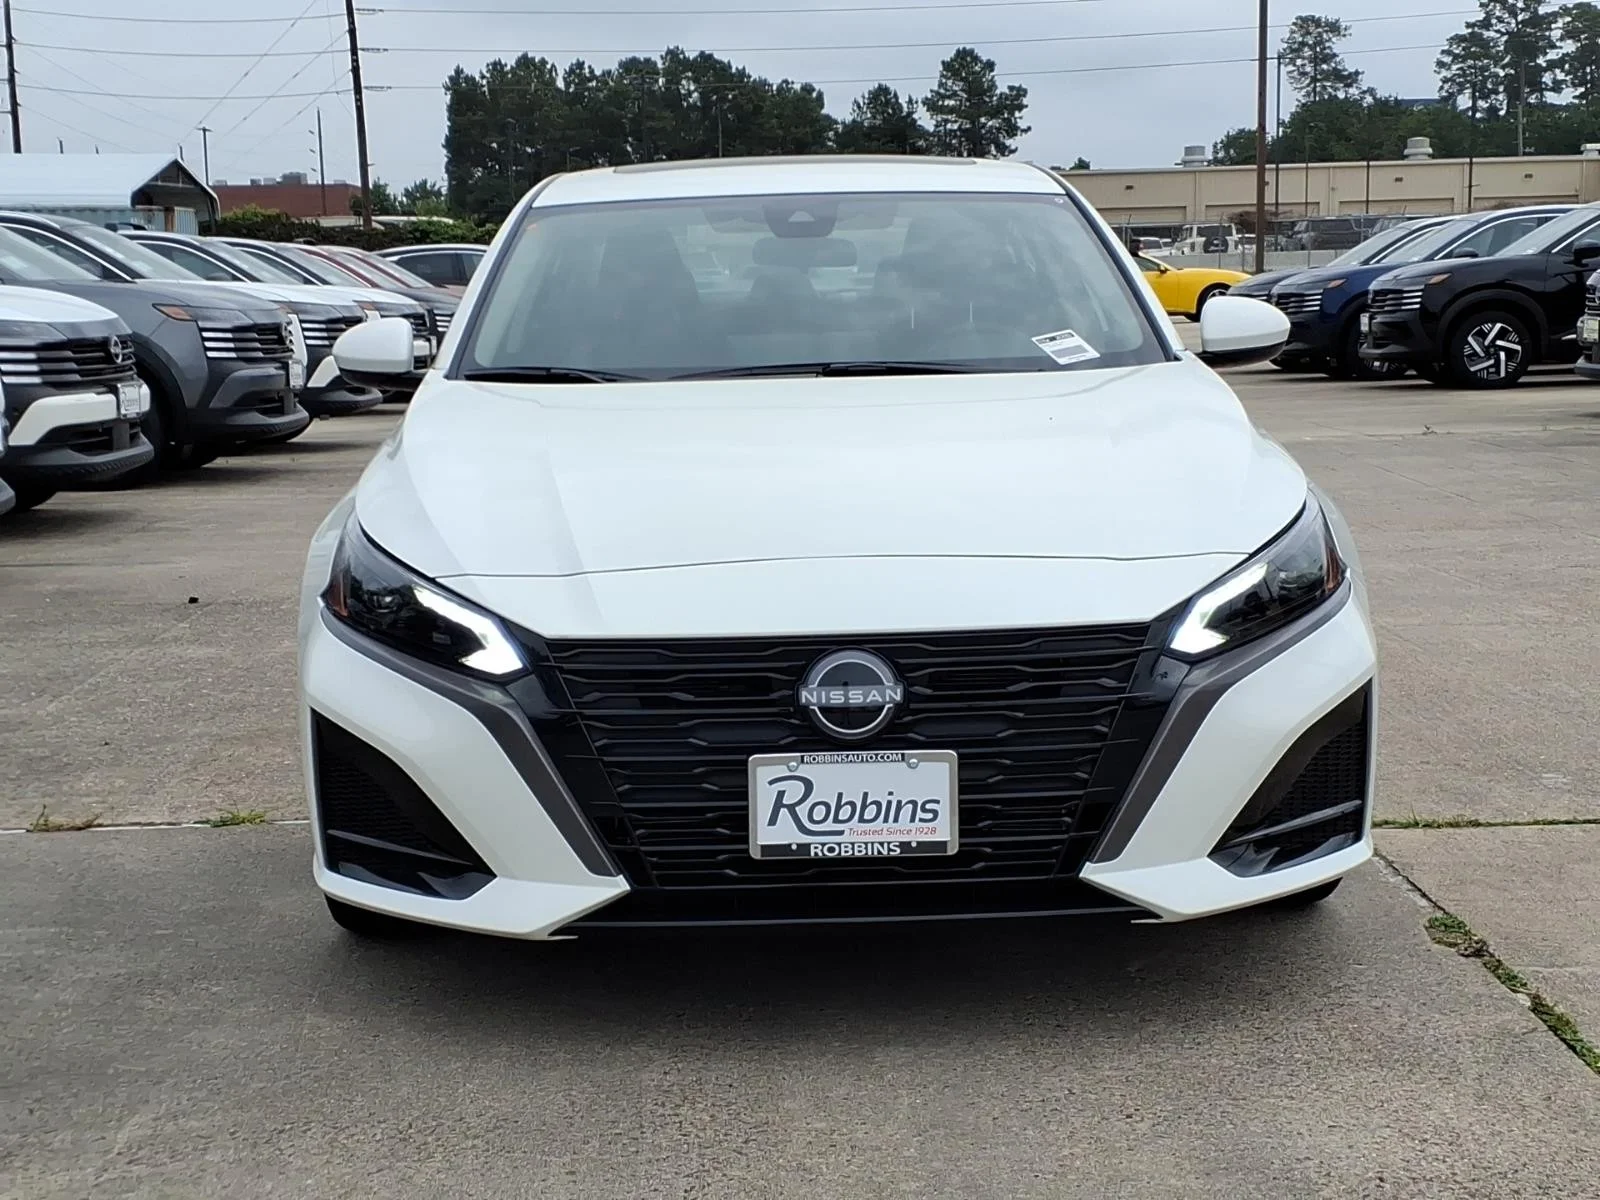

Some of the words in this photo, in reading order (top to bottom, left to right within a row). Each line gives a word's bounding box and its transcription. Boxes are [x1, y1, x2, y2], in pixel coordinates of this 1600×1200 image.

[801, 688, 901, 704] NISSAN
[804, 753, 902, 764] ROBBINSAUTO.COM
[767, 774, 941, 837] Robbins
[848, 827, 883, 837] Trusted
[886, 827, 912, 836] Since
[915, 826, 937, 835] 1928
[810, 841, 901, 857] ROBBINS
